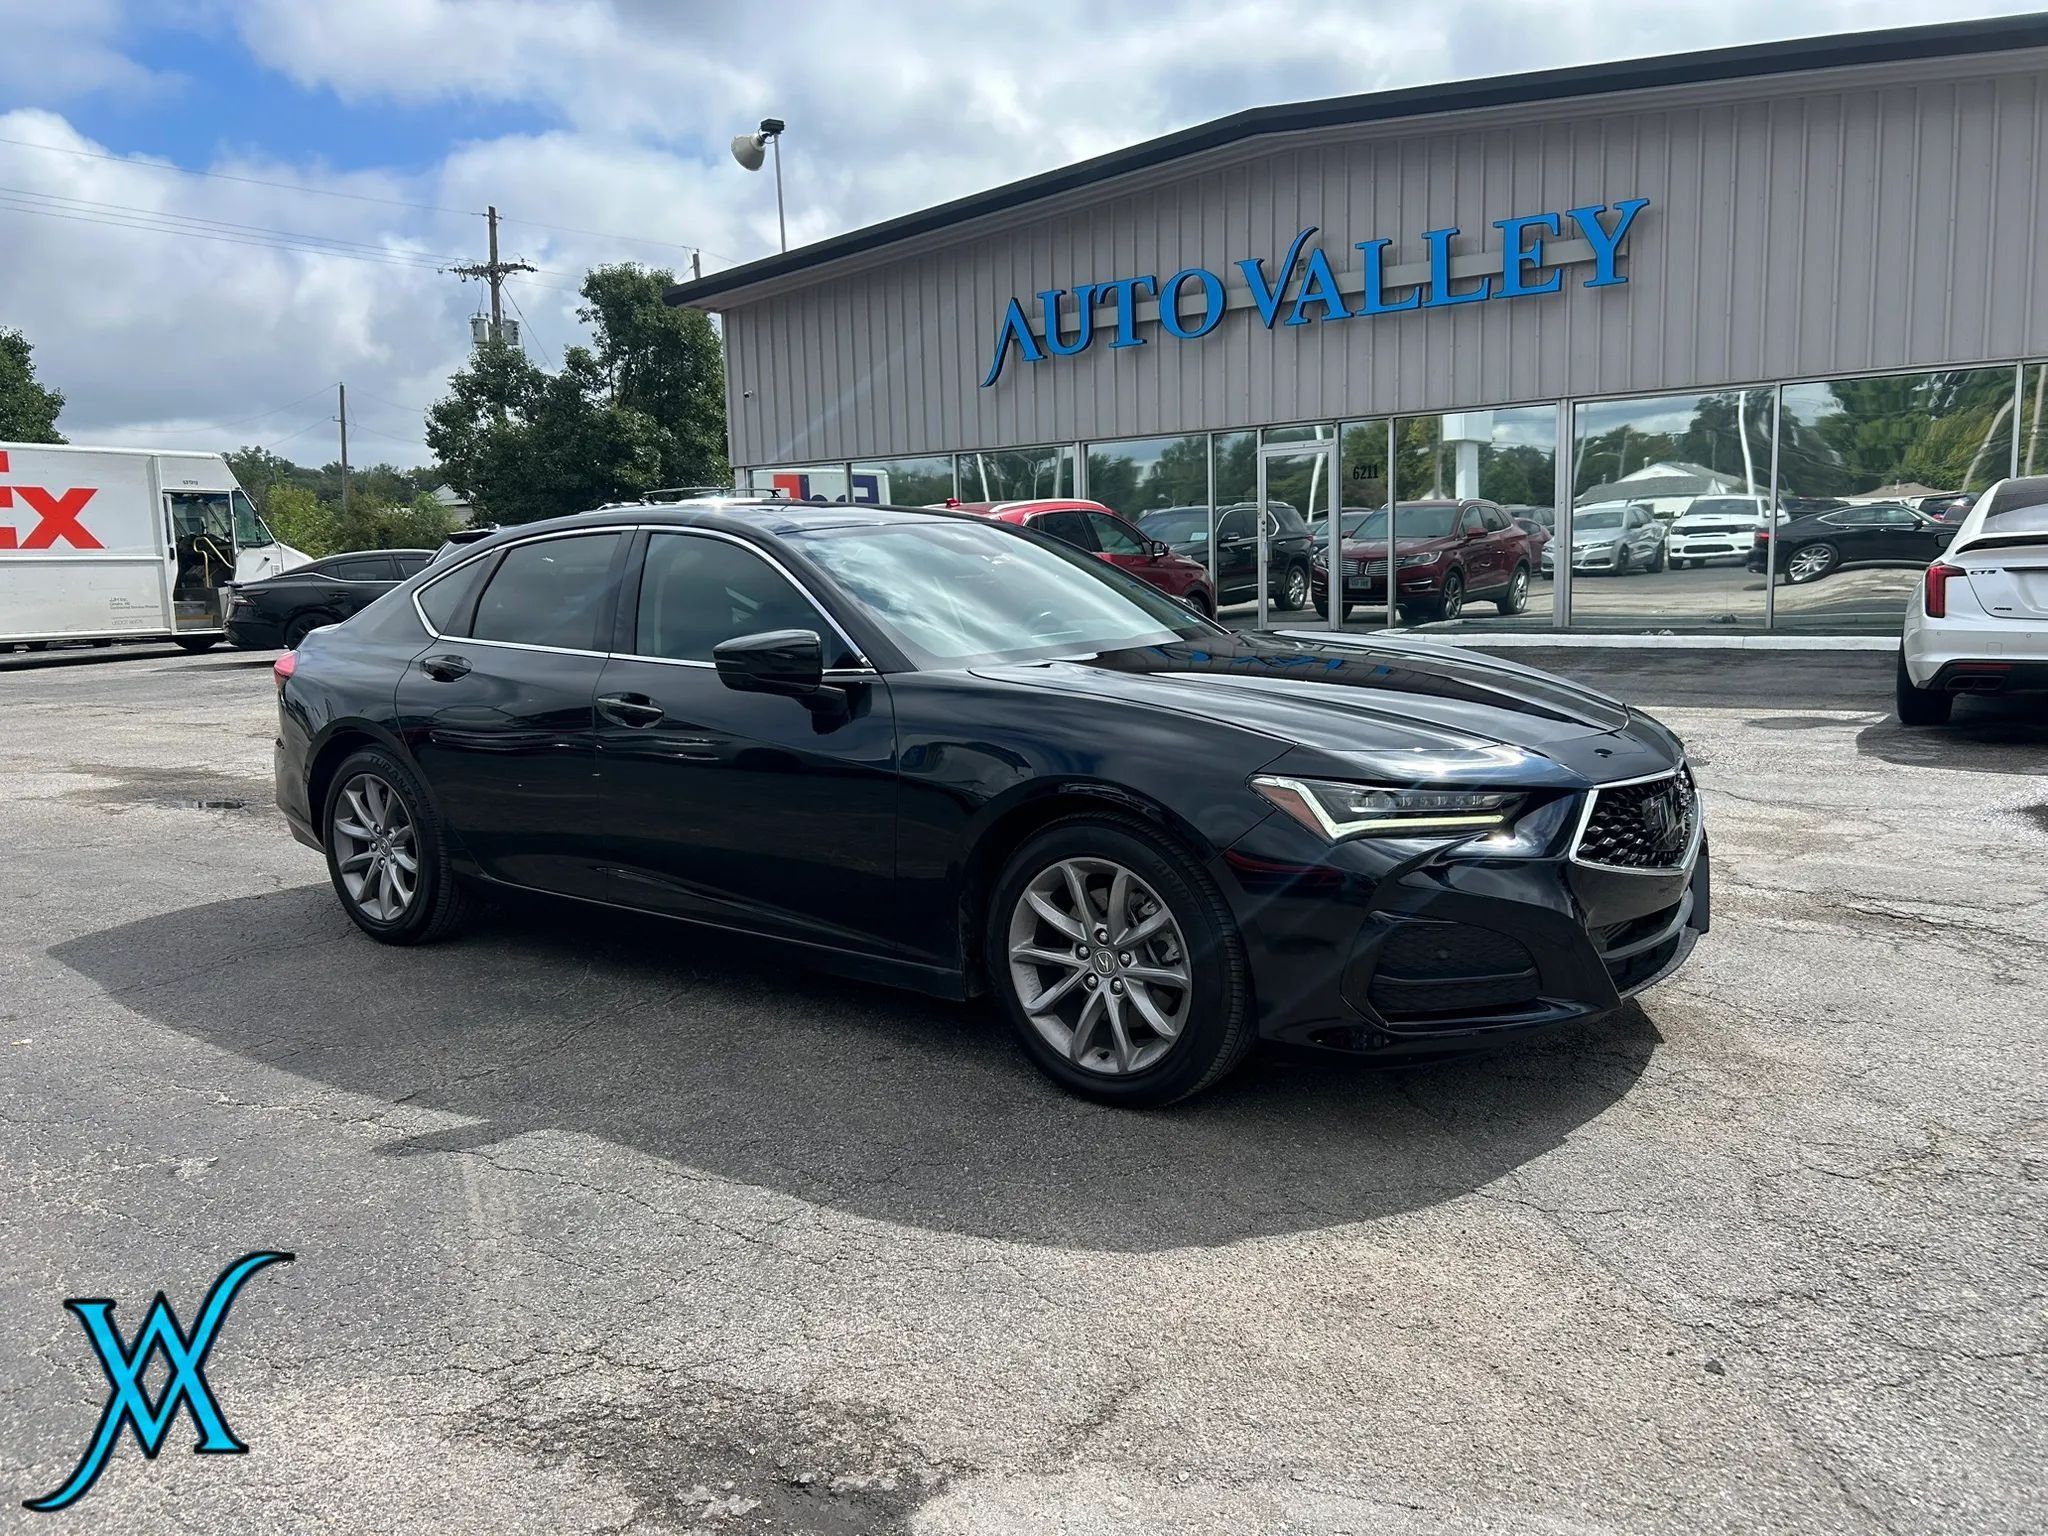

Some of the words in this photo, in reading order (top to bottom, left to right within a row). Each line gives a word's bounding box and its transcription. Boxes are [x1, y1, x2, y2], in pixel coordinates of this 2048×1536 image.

[980, 268, 1226, 387] AUTO
[1235, 198, 1650, 329] VALLEY
[1353, 464, 1378, 480] 6211
[368, 755, 418, 809] TURANZA
